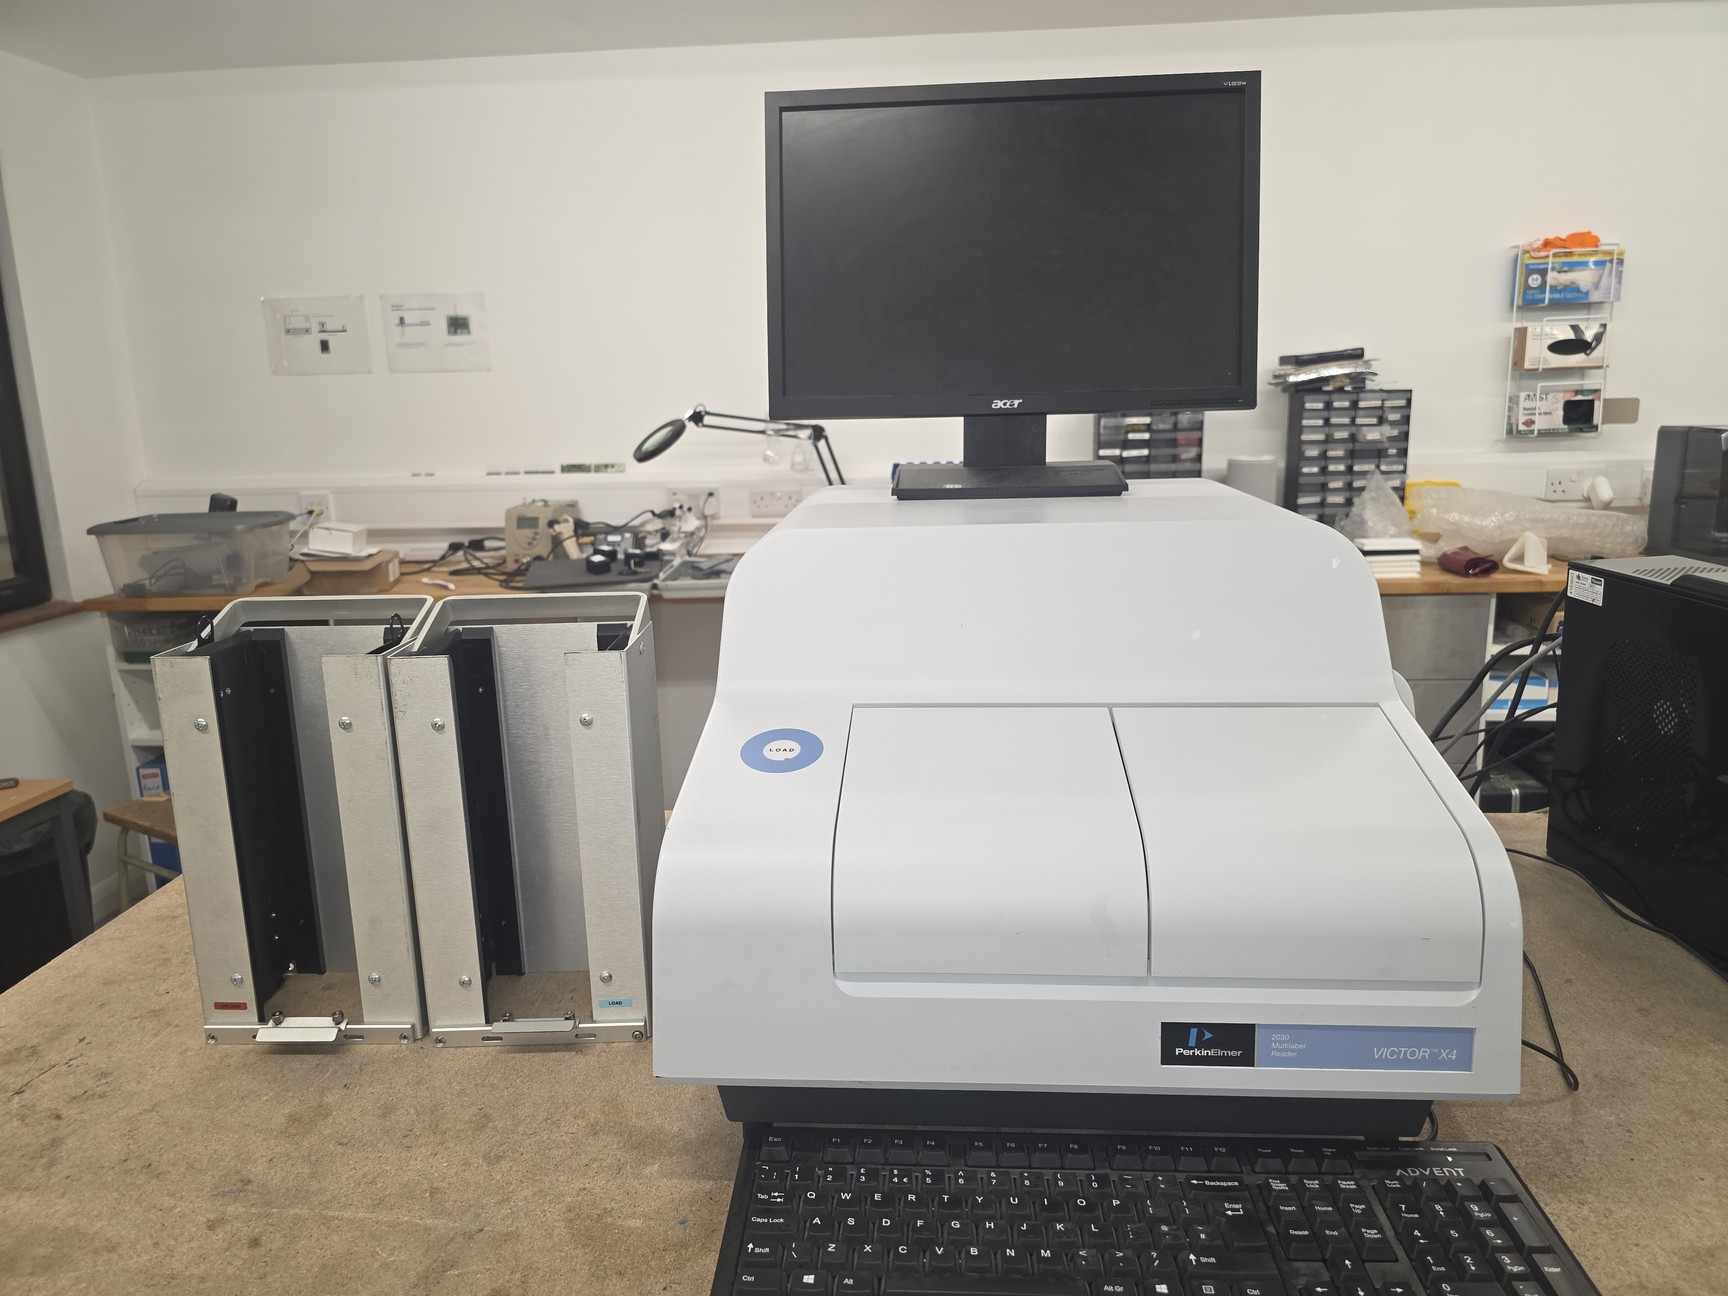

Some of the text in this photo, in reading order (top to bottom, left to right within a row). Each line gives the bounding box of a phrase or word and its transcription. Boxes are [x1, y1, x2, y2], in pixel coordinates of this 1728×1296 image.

[991, 399, 1022, 409] acer
[1175, 1048, 1243, 1057] PerkinElmer
[1438, 1049, 1457, 1060] X4
[1396, 1168, 1465, 1176] ADVENT
[1091, 1224, 1098, 1232] L
[828, 1244, 836, 1252] Z
